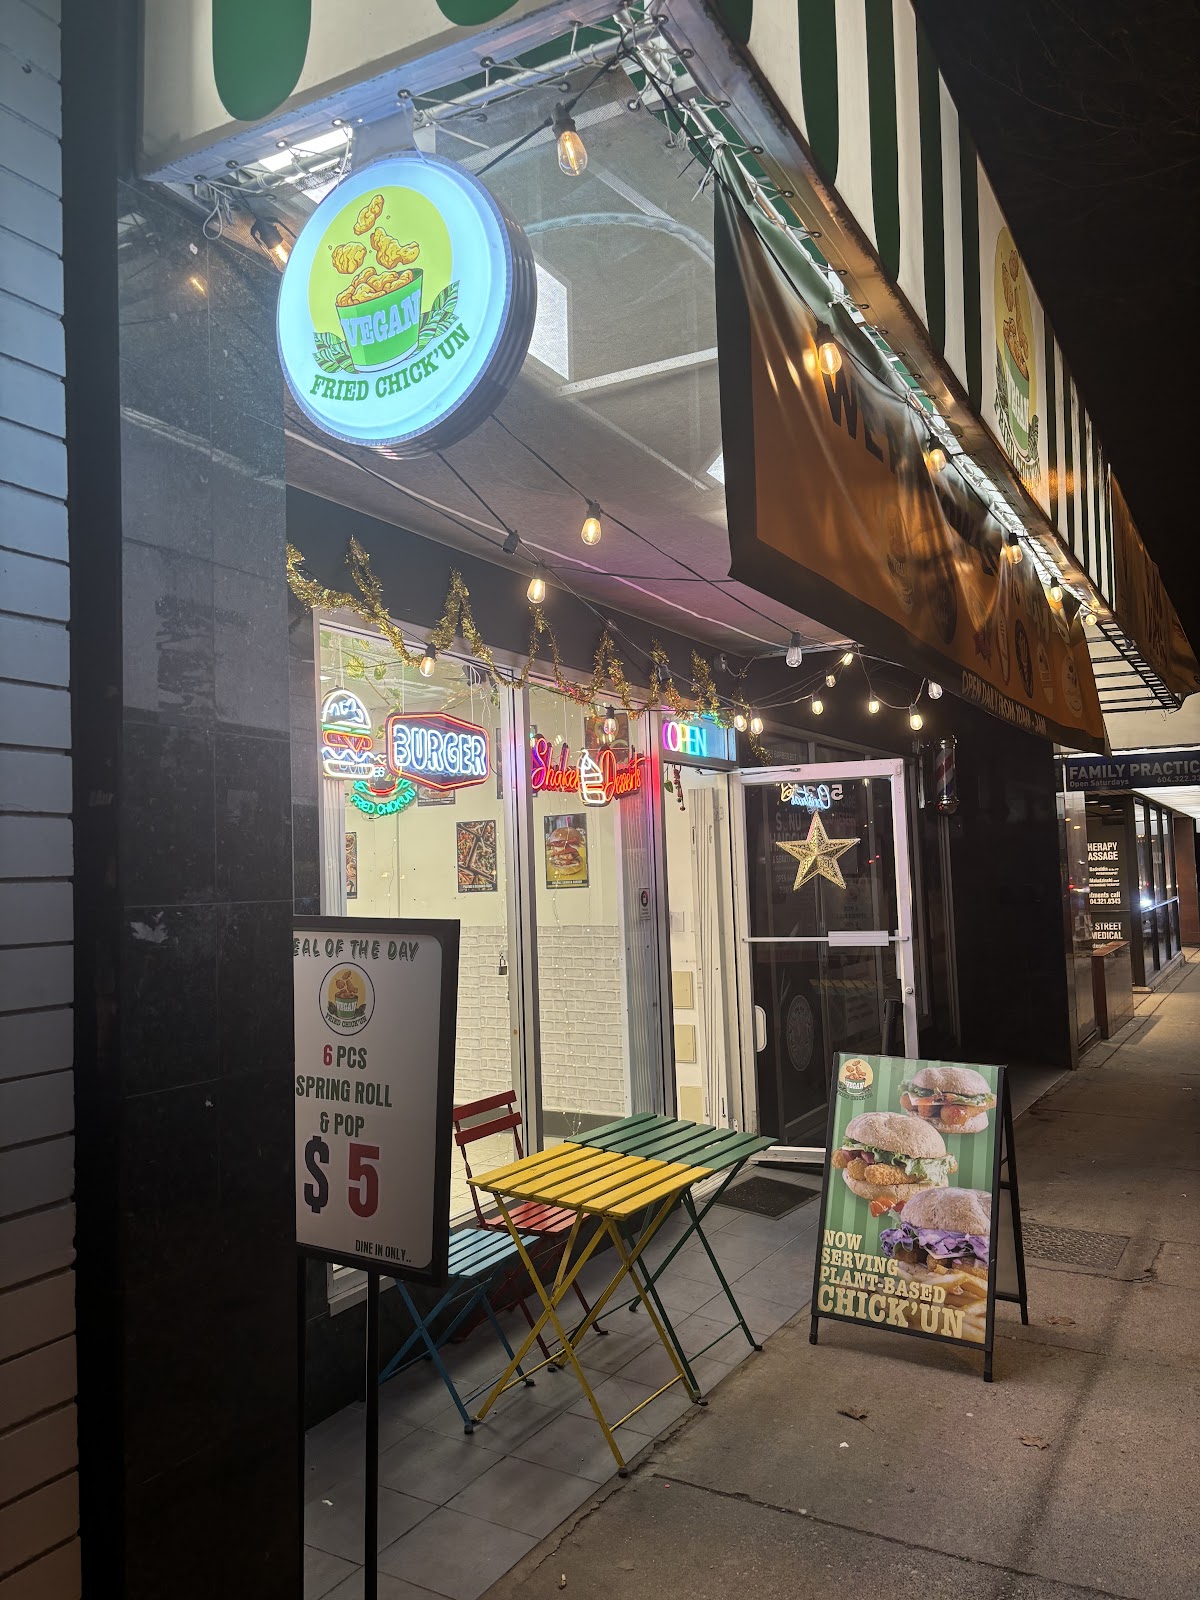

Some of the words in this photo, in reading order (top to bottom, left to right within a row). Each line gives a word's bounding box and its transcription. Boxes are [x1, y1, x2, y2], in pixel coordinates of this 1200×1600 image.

[340, 289, 421, 348] VEGAN
[309, 374, 370, 402] FRIED
[374, 323, 471, 399] CHICK'UN
[962, 669, 982, 701] OPEN
[394, 724, 487, 775] BURGER
[664, 721, 708, 757] OPEN
[531, 737, 580, 790] Shakes
[1069, 764, 1126, 780] FAMILY
[1129, 760, 1200, 777] PRACTIC
[1090, 779, 1129, 787] Saturdays
[1157, 774, 1200, 783] 604.322.33
[1087, 842, 1118, 852] HERAPY
[1087, 851, 1119, 861] ASSAGE
[1095, 922, 1123, 931] STREET
[293, 937, 321, 957] EAL
[324, 937, 344, 958] OF
[349, 939, 380, 960] THE
[387, 940, 420, 962] DAY
[335, 1000, 357, 1012] VEGAN
[323, 1043, 333, 1068] 6
[337, 1045, 368, 1071] PCS
[295, 1074, 351, 1103] SPRING
[354, 1080, 393, 1108] ROLL
[319, 1111, 329, 1135] &
[334, 1113, 365, 1138] POP
[303, 1135, 330, 1214] $
[348, 1142, 380, 1218] 5
[355, 1239, 373, 1256] DINE
[374, 1243, 384, 1258] IN
[823, 1229, 863, 1251] NOW
[821, 1247, 900, 1277] SERVING
[819, 1266, 946, 1304] PLANT-BASED
[817, 1285, 966, 1339] CHICK'UN
